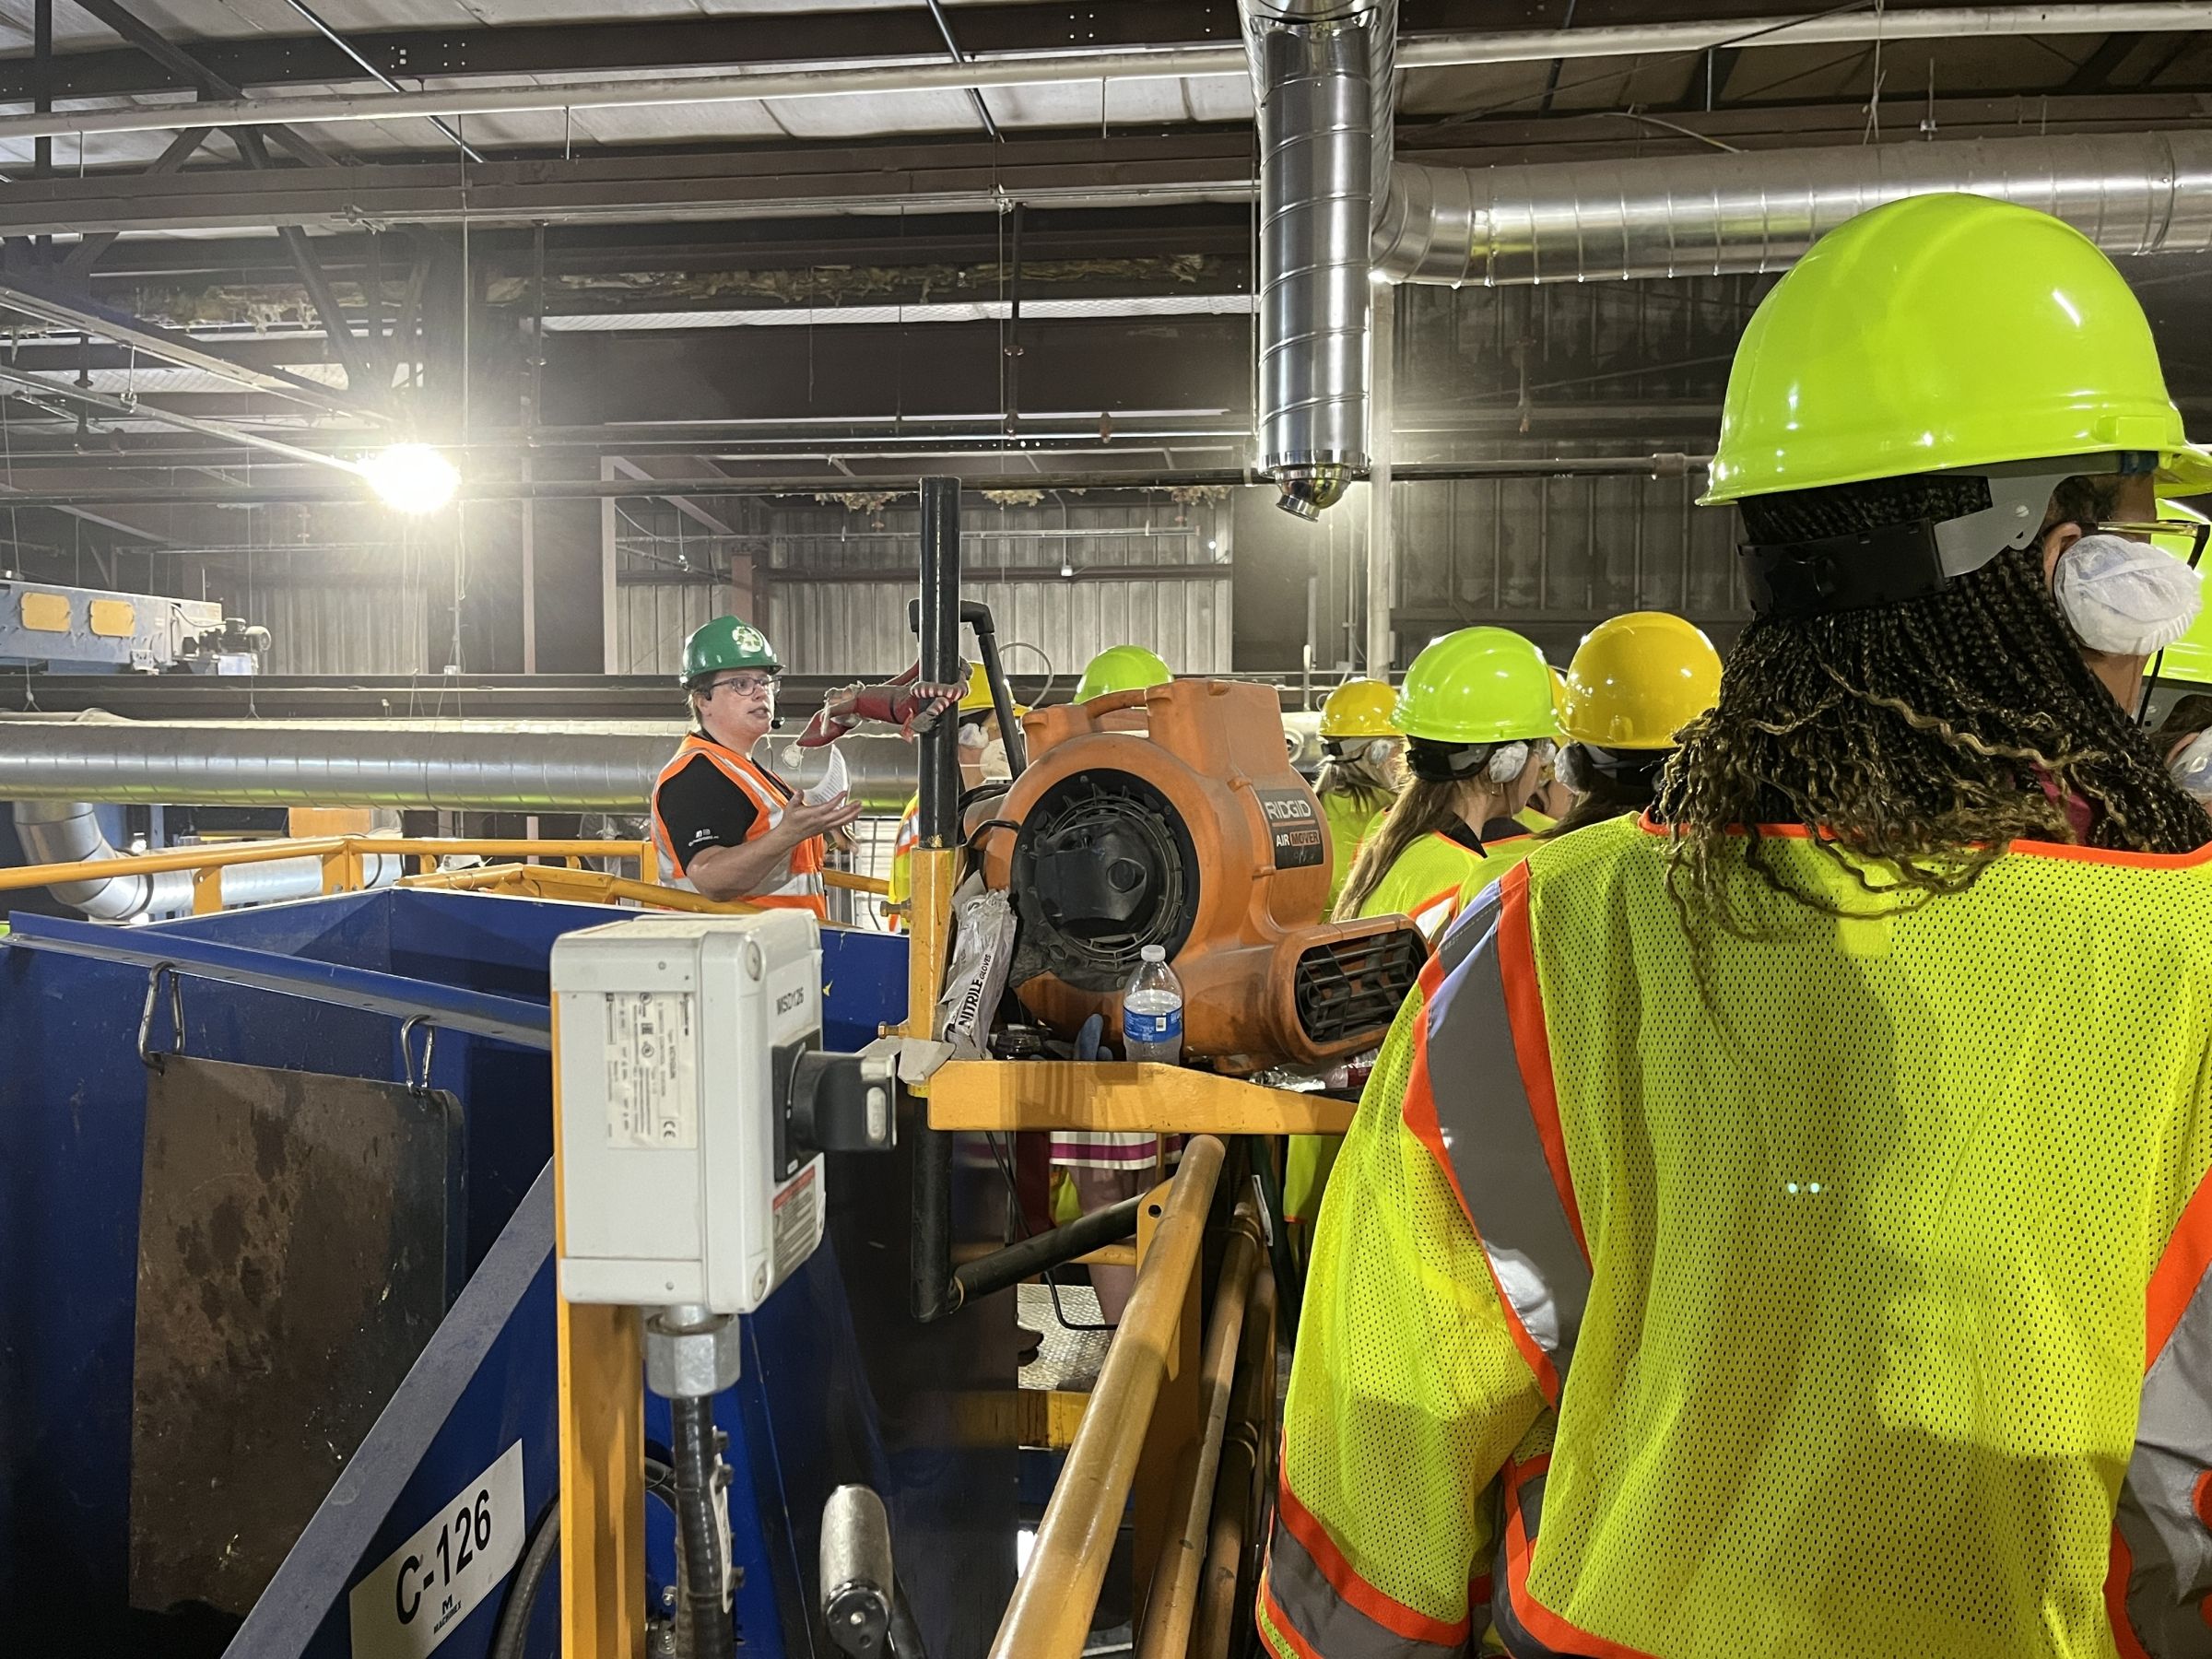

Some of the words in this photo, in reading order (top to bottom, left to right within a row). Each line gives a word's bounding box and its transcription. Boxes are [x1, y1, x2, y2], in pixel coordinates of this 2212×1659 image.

[1265, 799, 1312, 820] RIDGID
[1276, 833, 1290, 847] AIR
[1291, 831, 1320, 845] MOVER
[959, 979, 983, 1029] NITRILE
[979, 954, 992, 980] GLOVES
[396, 1489, 491, 1625] C-126
